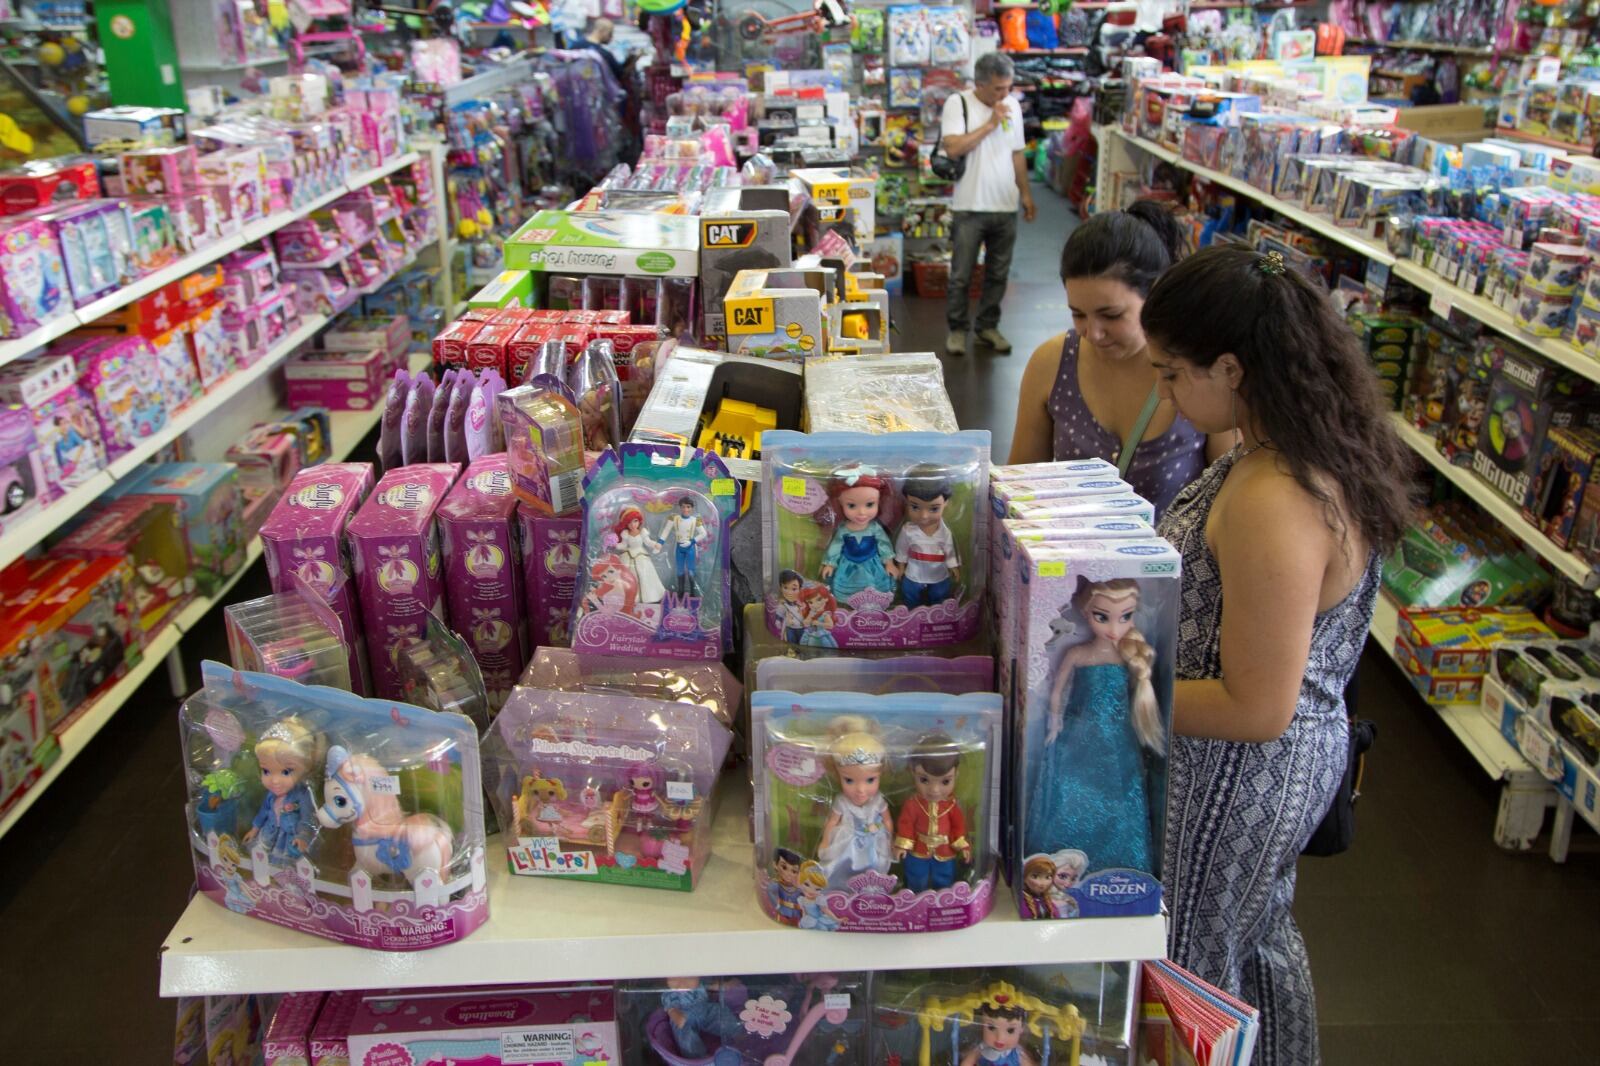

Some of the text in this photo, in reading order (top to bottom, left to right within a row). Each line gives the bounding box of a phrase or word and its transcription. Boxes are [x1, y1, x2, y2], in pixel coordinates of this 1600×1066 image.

[709, 225, 741, 245] CAT
[529, 250, 565, 267] Toys
[568, 251, 616, 269] Funny
[734, 307, 763, 326] CAT
[1504, 359, 1538, 388] SIGNOS
[1472, 449, 1528, 507] SIGNOS
[310, 482, 343, 510] Starfly
[400, 482, 432, 510] Starfly
[611, 633, 648, 645] Fairytale
[609, 643, 645, 655] Wedding
[1089, 882, 1147, 897] FROZEN
[857, 900, 893, 913] Disney
[400, 921, 448, 936] WARNING:
[458, 1009, 516, 1022] Rosalinda
[523, 1032, 572, 1042] WARNING:
[263, 1042, 305, 1058] Barbie
[310, 1041, 350, 1058] Barbie
